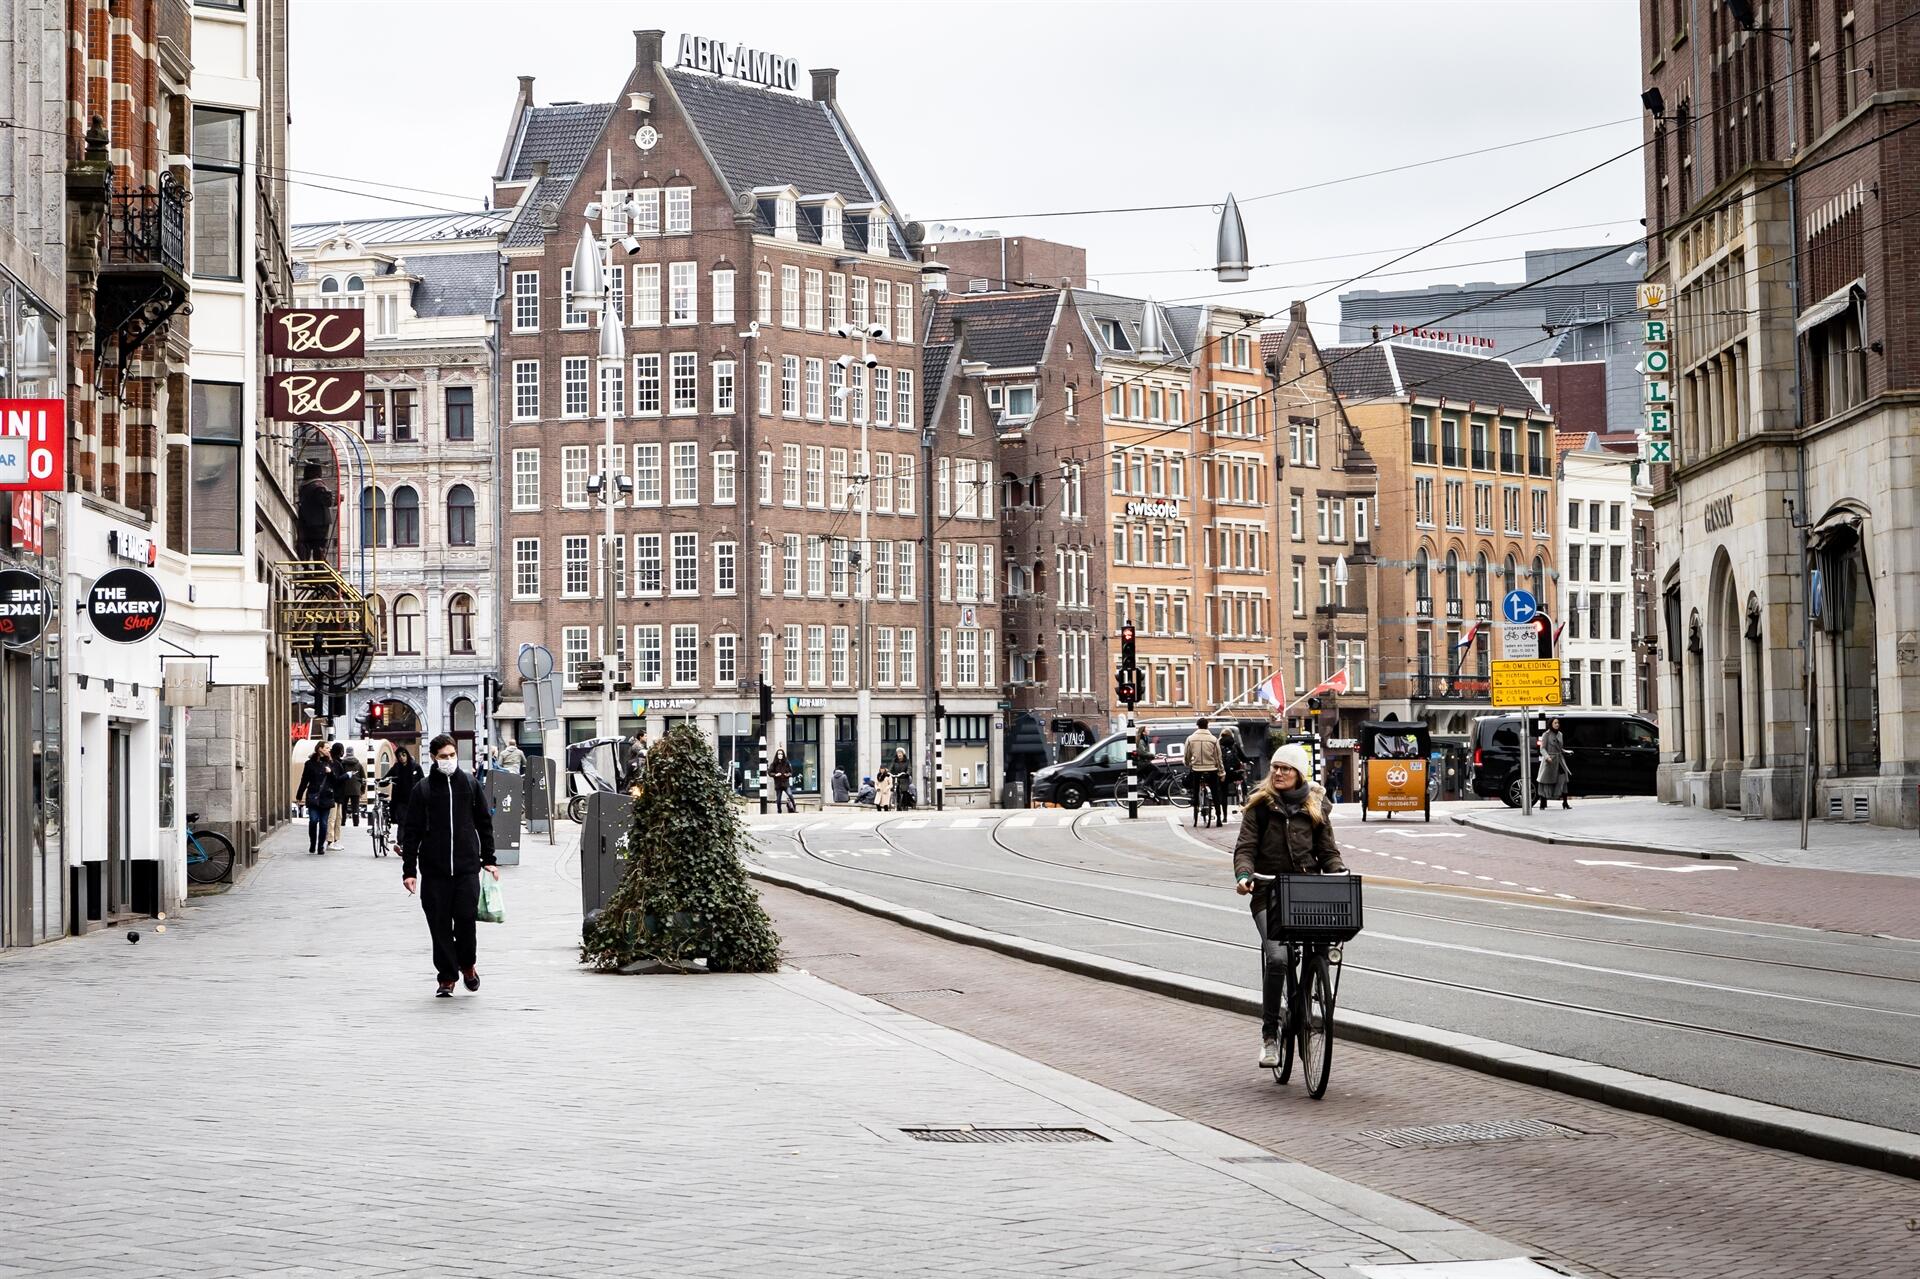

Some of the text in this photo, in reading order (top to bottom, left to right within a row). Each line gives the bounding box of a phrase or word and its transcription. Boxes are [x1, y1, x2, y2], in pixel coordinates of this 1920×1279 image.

[279, 313, 361, 352] P&C
[279, 376, 361, 415] P&C
[1646, 321, 1671, 463] ROLEX
[0, 410, 46, 441] NI
[95, 588, 126, 599] THE
[95, 602, 159, 614] BAKERY
[282, 610, 360, 624] TUSSAUD
[123, 615, 154, 631] Shop
